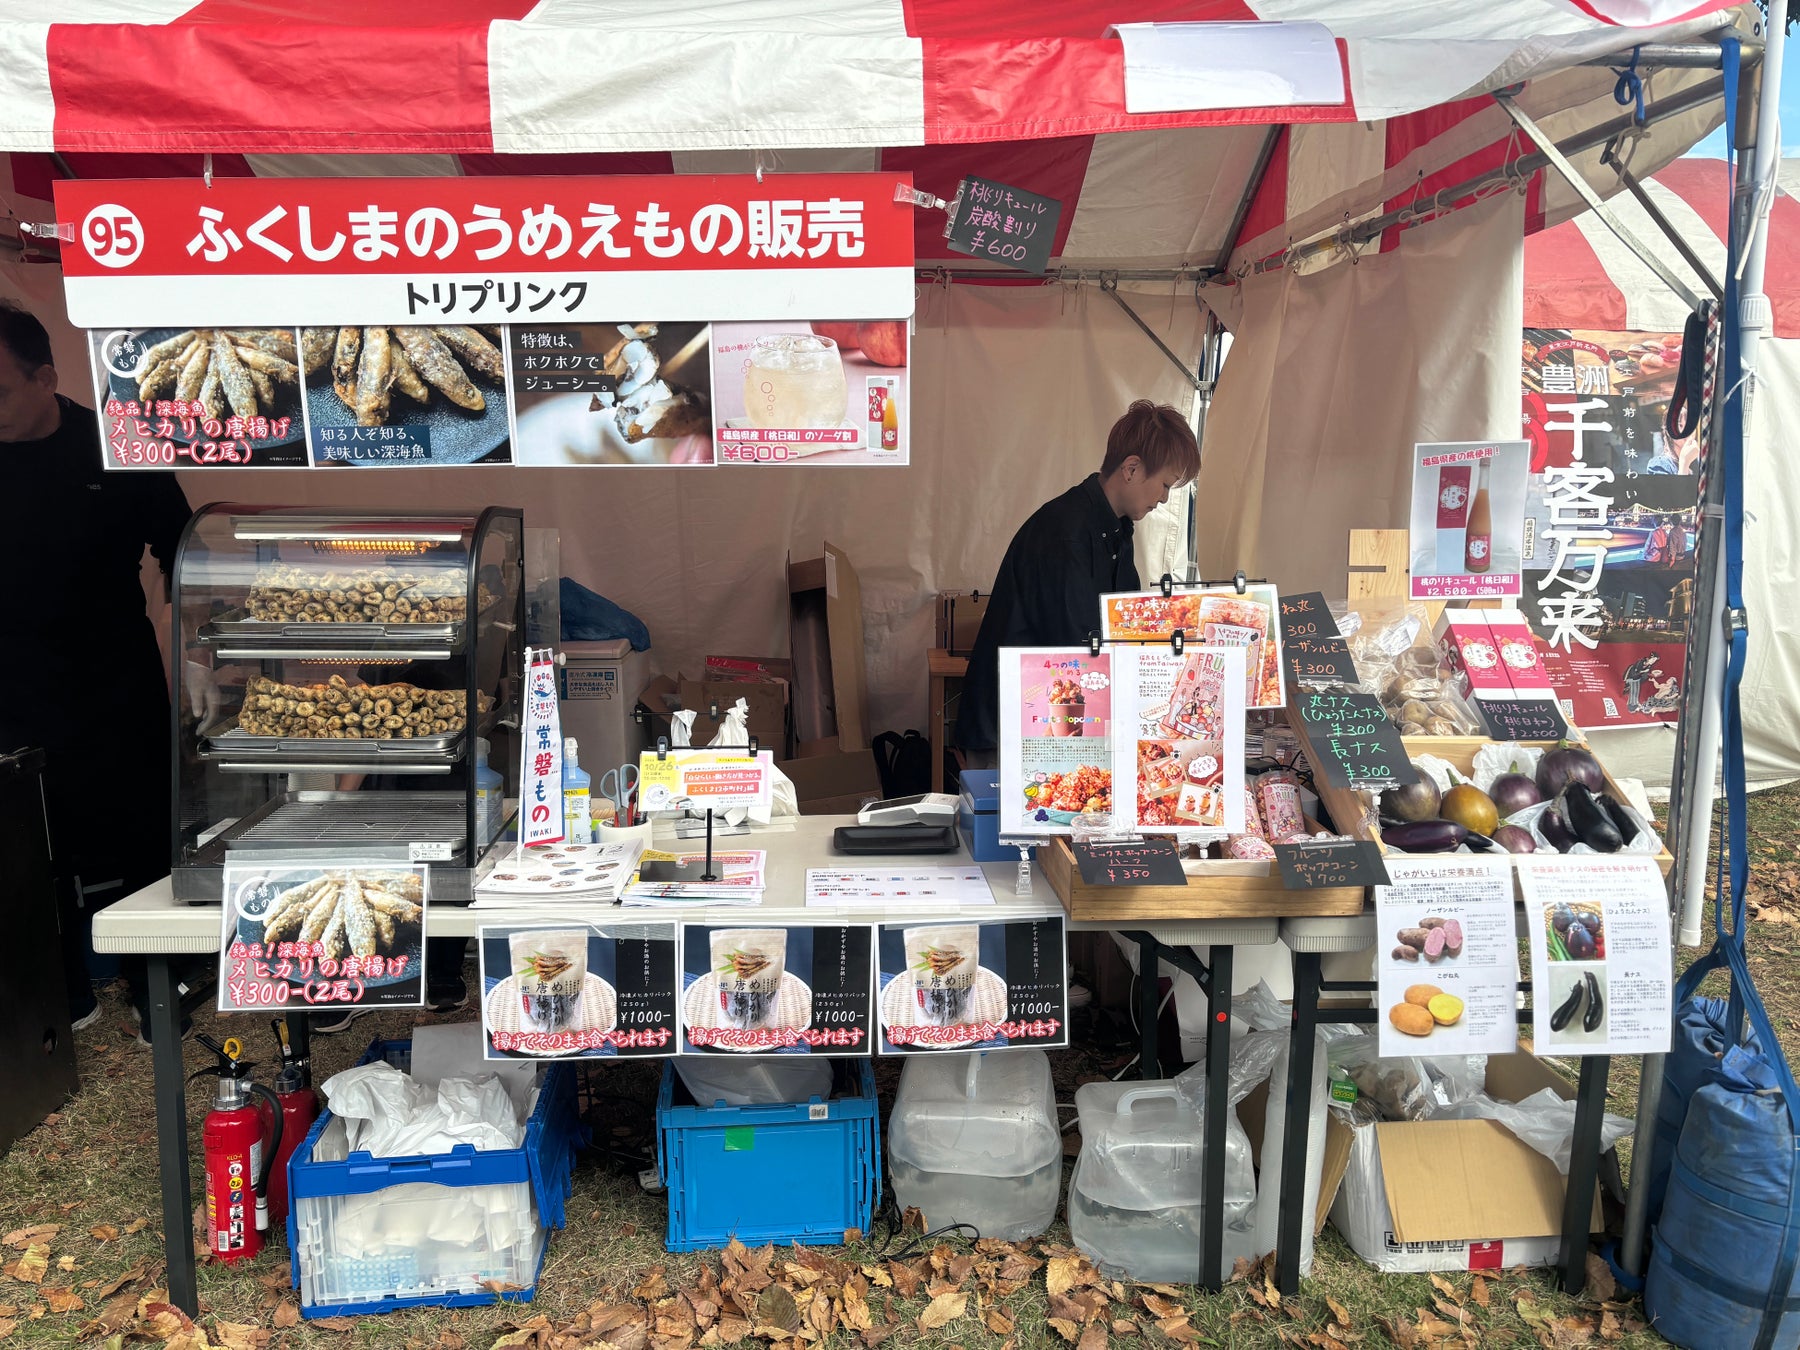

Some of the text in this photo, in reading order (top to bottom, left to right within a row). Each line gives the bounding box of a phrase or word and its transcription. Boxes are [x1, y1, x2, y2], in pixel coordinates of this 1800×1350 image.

[970, 181, 1047, 215] 桃リキュール
[186, 198, 865, 263] ふくしまのうめえもの販売
[965, 205, 1037, 239] 炭酸割り
[89, 217, 136, 257] 95
[406, 279, 588, 315] トリプリンク
[521, 333, 574, 349] 特徴は、
[524, 356, 599, 369] ホクホクで
[525, 376, 608, 391] ジューシー。
[1541, 364, 1610, 394] 豊洲
[108, 401, 206, 416] 絶品！深海魚
[111, 417, 290, 439] メヒカリの唐揚げ
[320, 427, 416, 442] 知る人ぞ知る、
[1621, 368, 1639, 499] 江戸前を味わい
[323, 444, 425, 460] 美味しい深海魚
[1422, 447, 1500, 466] 福島県産の桃使用！
[1537, 397, 1615, 654] 千客万来
[1115, 598, 1169, 611] 4つの味が
[1044, 659, 1088, 669] 4つの味が
[1310, 695, 1356, 708] 丸ナス
[1331, 722, 1376, 737] ¥300
[1331, 740, 1387, 759] 長ナス
[532, 724, 554, 824] 常磐もの
[1343, 762, 1390, 780] ¥300
[530, 828, 552, 838] IWAKI
[1288, 849, 1332, 860] フルーツ
[1293, 861, 1359, 872] ポップコーン
[1394, 867, 1490, 878] じゃがいもは栄養満点！
[1107, 869, 1150, 882] ¥350
[1304, 873, 1346, 886] ¥700
[231, 941, 325, 958] 絶品！深海魚
[229, 956, 408, 979] メヒカリの唐揚げ
[492, 1027, 672, 1050] 揚げてそのまま食べられます
[688, 1026, 865, 1047] 揚げてそのまま食べられます
[887, 1018, 1061, 1045] 揚げてそのまま食べられます
